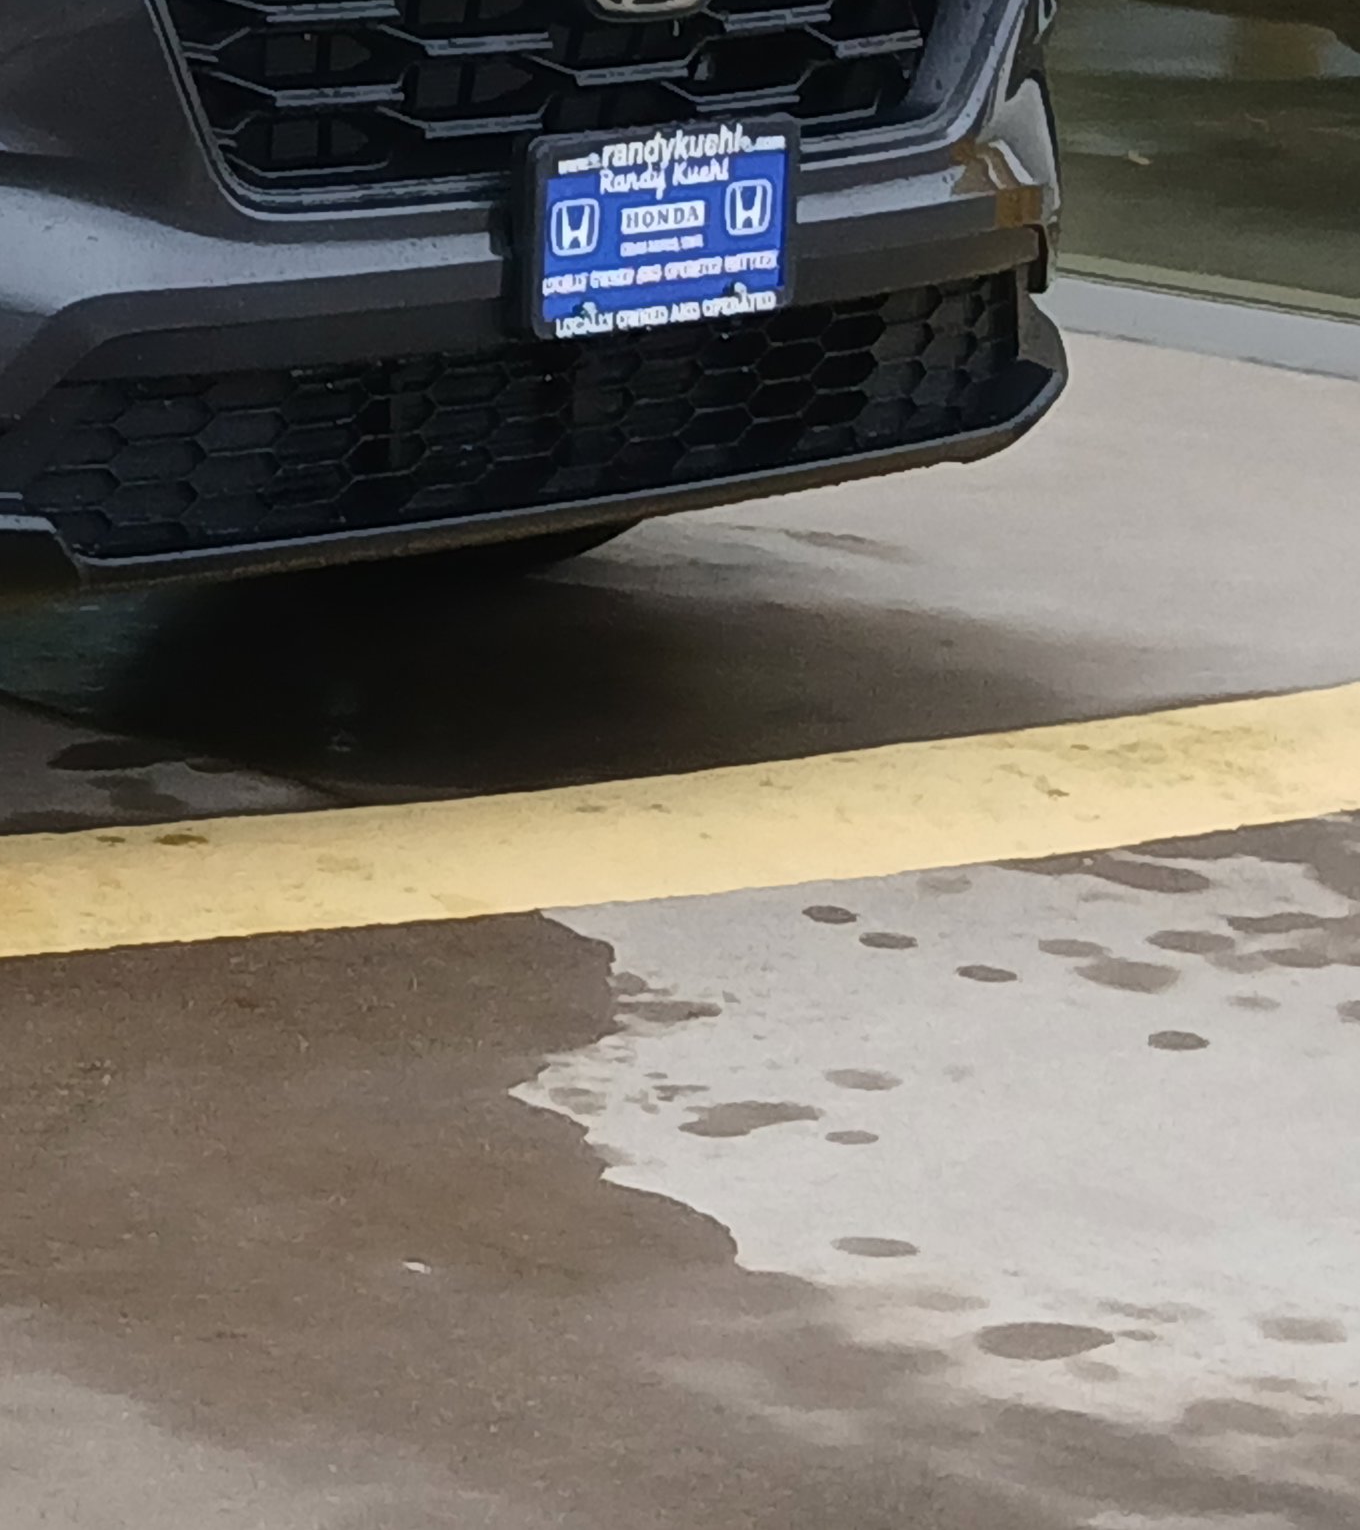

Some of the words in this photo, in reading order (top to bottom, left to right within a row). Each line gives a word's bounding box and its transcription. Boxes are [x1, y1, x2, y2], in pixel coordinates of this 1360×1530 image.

[600, 165, 666, 200] Randy
[672, 157, 729, 186] Kuehl
[625, 205, 700, 229] HONDA
